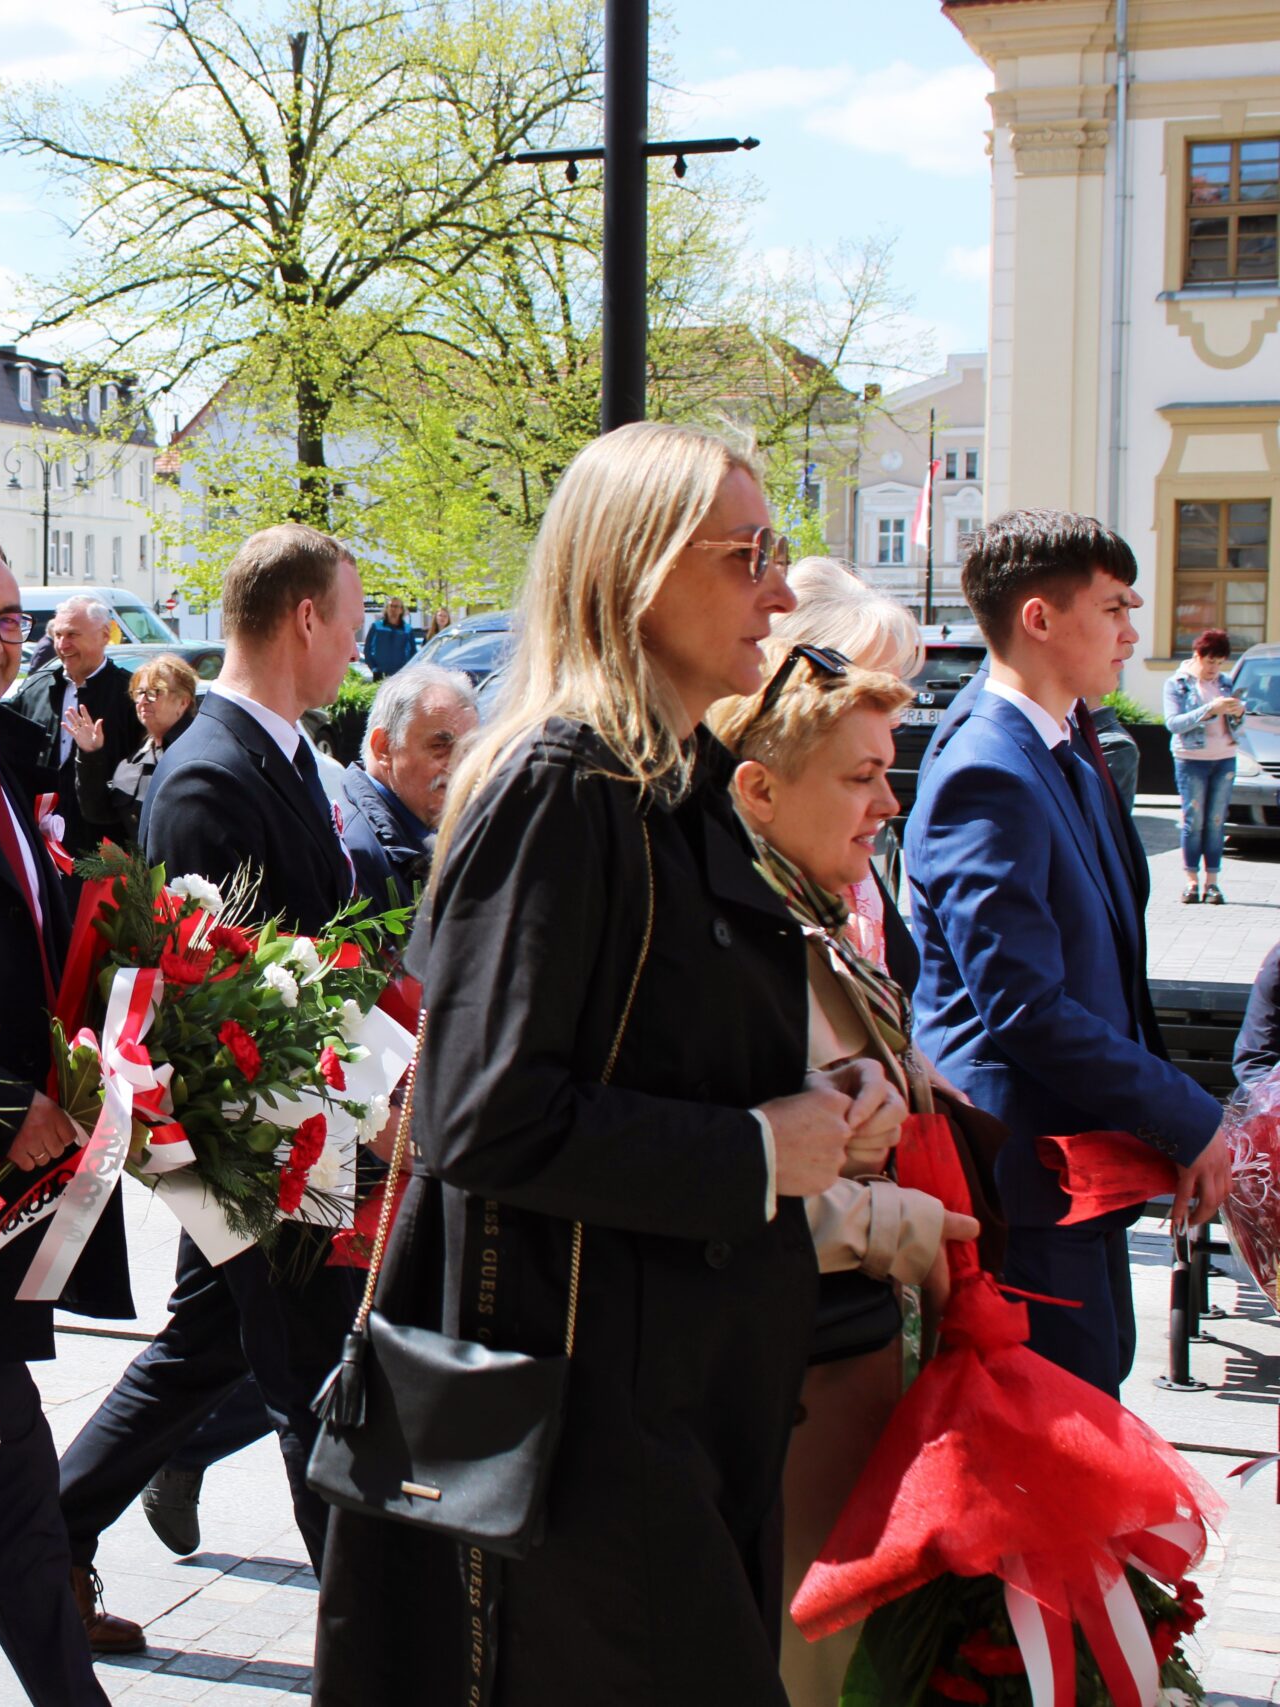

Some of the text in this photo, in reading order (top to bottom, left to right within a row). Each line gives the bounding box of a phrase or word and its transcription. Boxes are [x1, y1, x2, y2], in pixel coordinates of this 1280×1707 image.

[484, 1199, 499, 1236] ESS
[478, 1248, 497, 1316] GUESS
[469, 1546, 483, 1609] GUESS
[472, 1615, 483, 1678] GUESS
